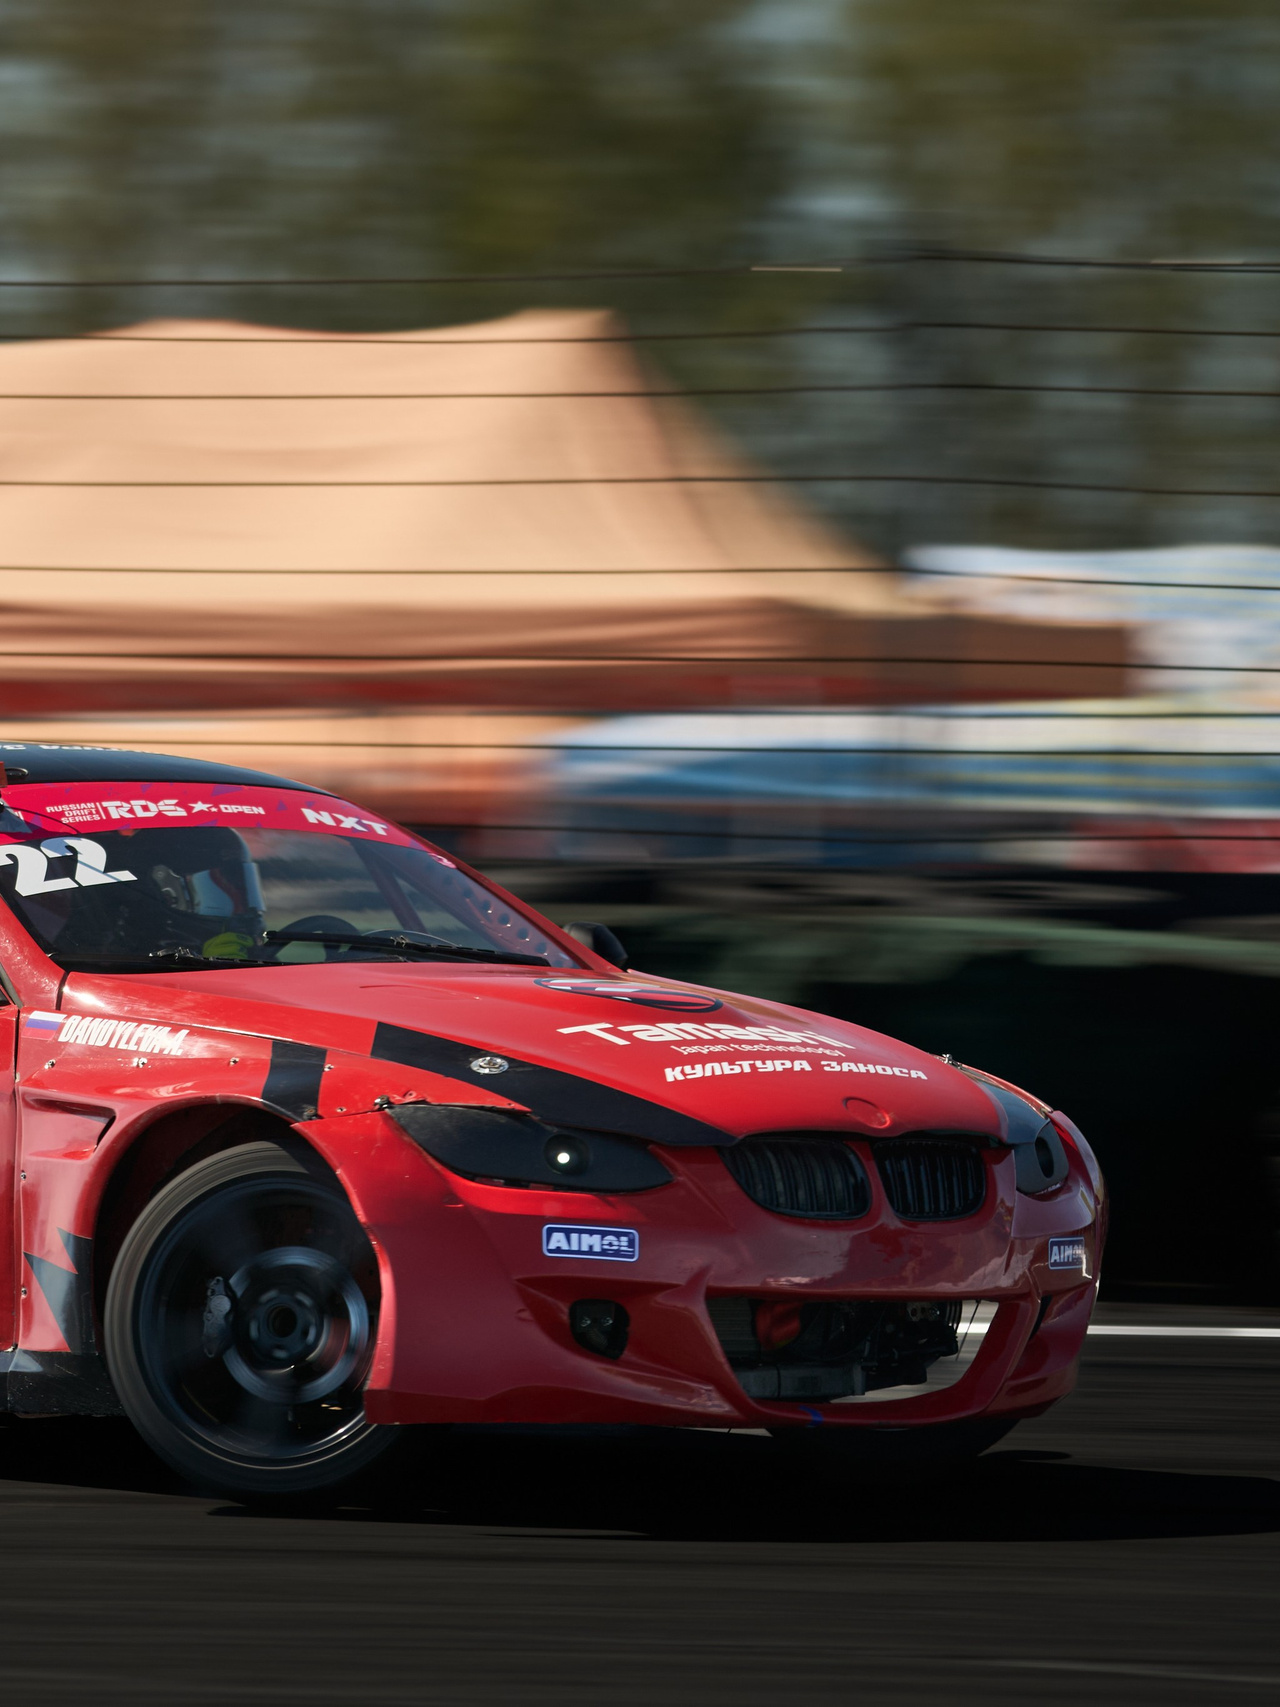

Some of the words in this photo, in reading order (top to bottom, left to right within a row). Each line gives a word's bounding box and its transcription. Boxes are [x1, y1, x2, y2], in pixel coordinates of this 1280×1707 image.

[45, 802, 96, 813] RUSSIAN
[64, 808, 97, 817] DRIFT
[101, 800, 188, 819] RDS
[220, 804, 266, 815] OPEN
[61, 814, 101, 824] SERIES
[301, 808, 388, 836] NXT
[556, 1022, 856, 1050] Tamashi
[670, 1043, 728, 1055] Japan
[664, 1060, 812, 1082] КУЛЬТУРА
[821, 1060, 928, 1080] ЗАНОСА
[547, 1232, 635, 1255] AIMOL
